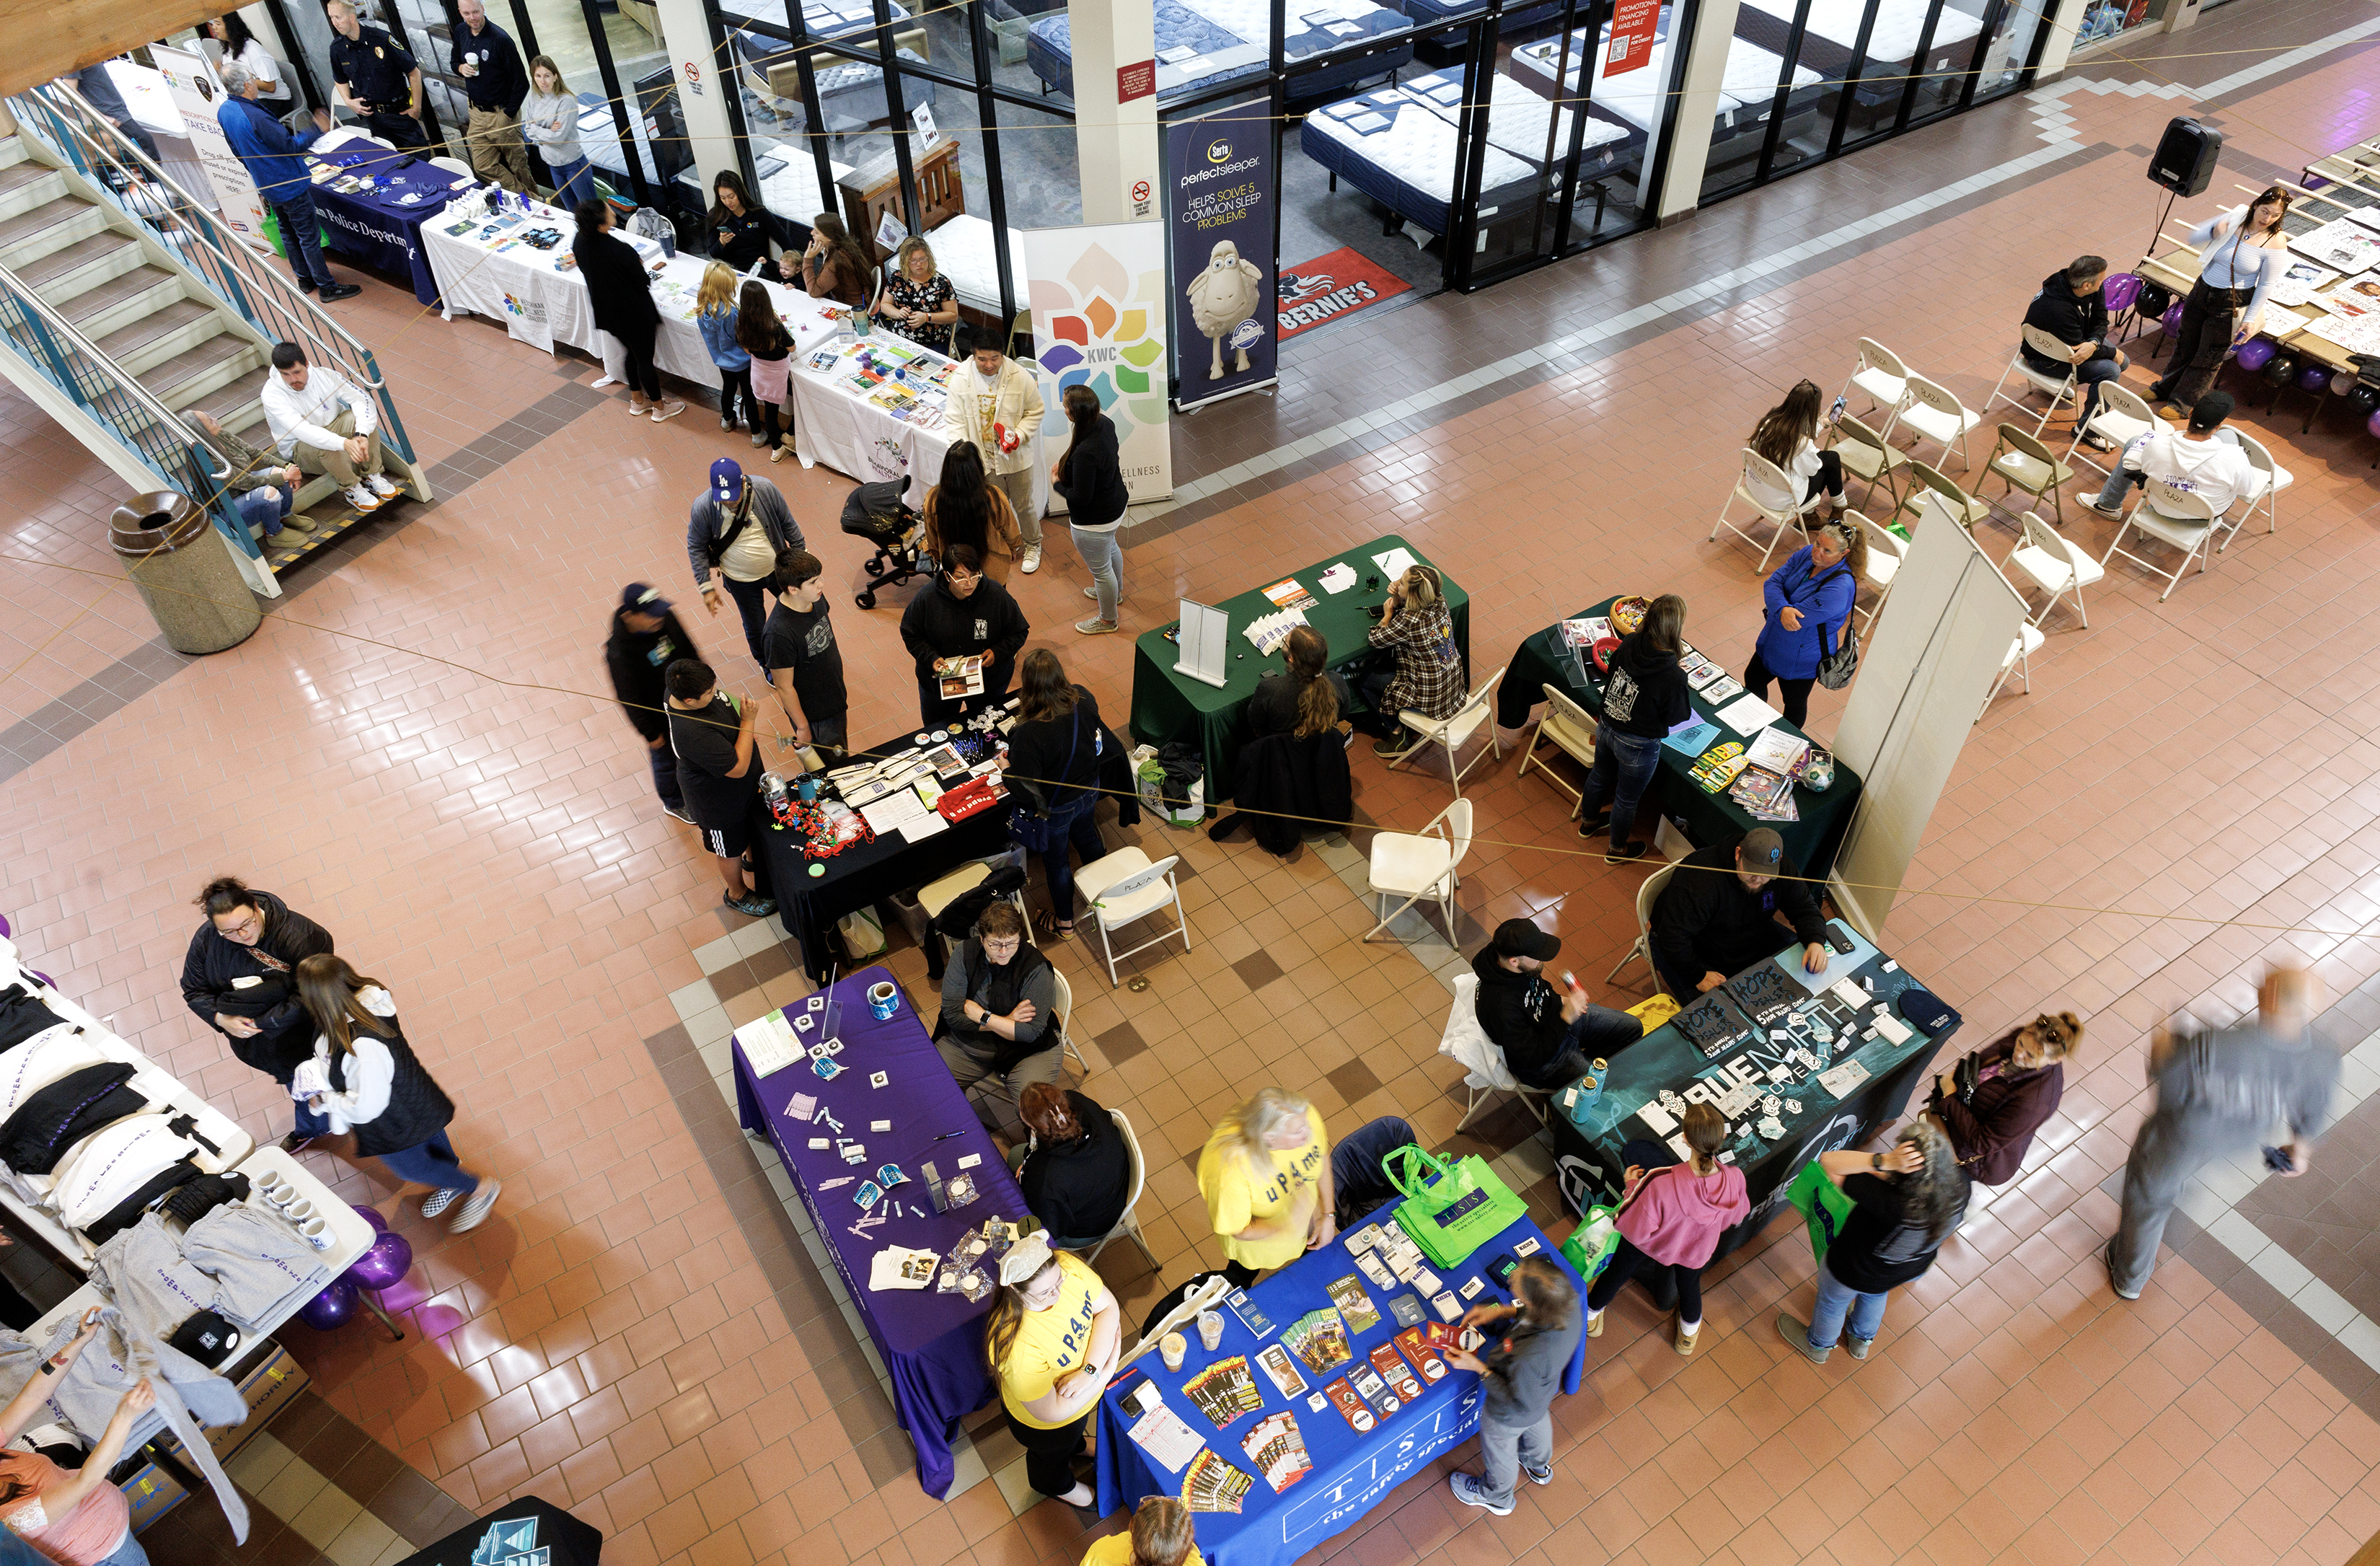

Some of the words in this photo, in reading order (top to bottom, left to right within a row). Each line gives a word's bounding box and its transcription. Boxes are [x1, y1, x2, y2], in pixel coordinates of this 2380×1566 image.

[1620, 0, 1657, 14] PROMOTIONAL
[1618, 9, 1649, 22] FINANCING
[180, 110, 211, 123] PRESCRIPTION
[184, 118, 207, 133] TAKE
[209, 124, 225, 138] BAC
[200, 148, 215, 161] Drop
[1212, 144, 1229, 157] Serta
[201, 159, 221, 172] unused
[227, 167, 248, 180] expired
[212, 172, 246, 188] prescriptions
[1189, 193, 1215, 210] HELPS
[1217, 185, 1246, 202] SOLVE
[1248, 182, 1255, 193] 5
[1182, 200, 1234, 223] COMMON
[1235, 192, 1261, 208] SLEEP
[1198, 208, 1246, 231] PROBLEMS
[325, 208, 359, 232] Police
[358, 221, 416, 260] Departmt
[520, 298, 545, 309] KETCHIKAN
[1278, 280, 1378, 330] BERNIE'S
[2035, 333, 2053, 351] PLAZA
[1087, 346, 1117, 364] KWC
[1869, 350, 1887, 366] PLAZA
[1920, 387, 1941, 404] PLAZA
[2113, 395, 2131, 410] PLAZA
[1121, 465, 1160, 478] ELLNESS
[1753, 460, 1769, 480] PLAZA
[718, 475, 728, 487] LA
[2165, 475, 2186, 484] STOMP
[2164, 489, 2184, 504] PLAZA
[1559, 702, 1577, 721] PLAZA
[966, 796, 992, 809] Proud
[1124, 876, 1152, 892] PLAZA
[1731, 964, 1784, 1005] HOPE
[1750, 985, 1791, 1007] DEALER
[1677, 997, 1727, 1034] HOPE
[1696, 1017, 1735, 1042] DEALER
[1825, 1079, 1837, 1088] TRUE
[1460, 1215, 1472, 1225] safety
[1473, 1200, 1494, 1216] specialists
[1320, 1307, 1336, 1316] TEEN
[1349, 1364, 1367, 1378] Paternity
[1326, 1384, 1337, 1393] DNA
[1323, 1505, 1355, 1524] the
[1362, 1459, 1413, 1503] safety
